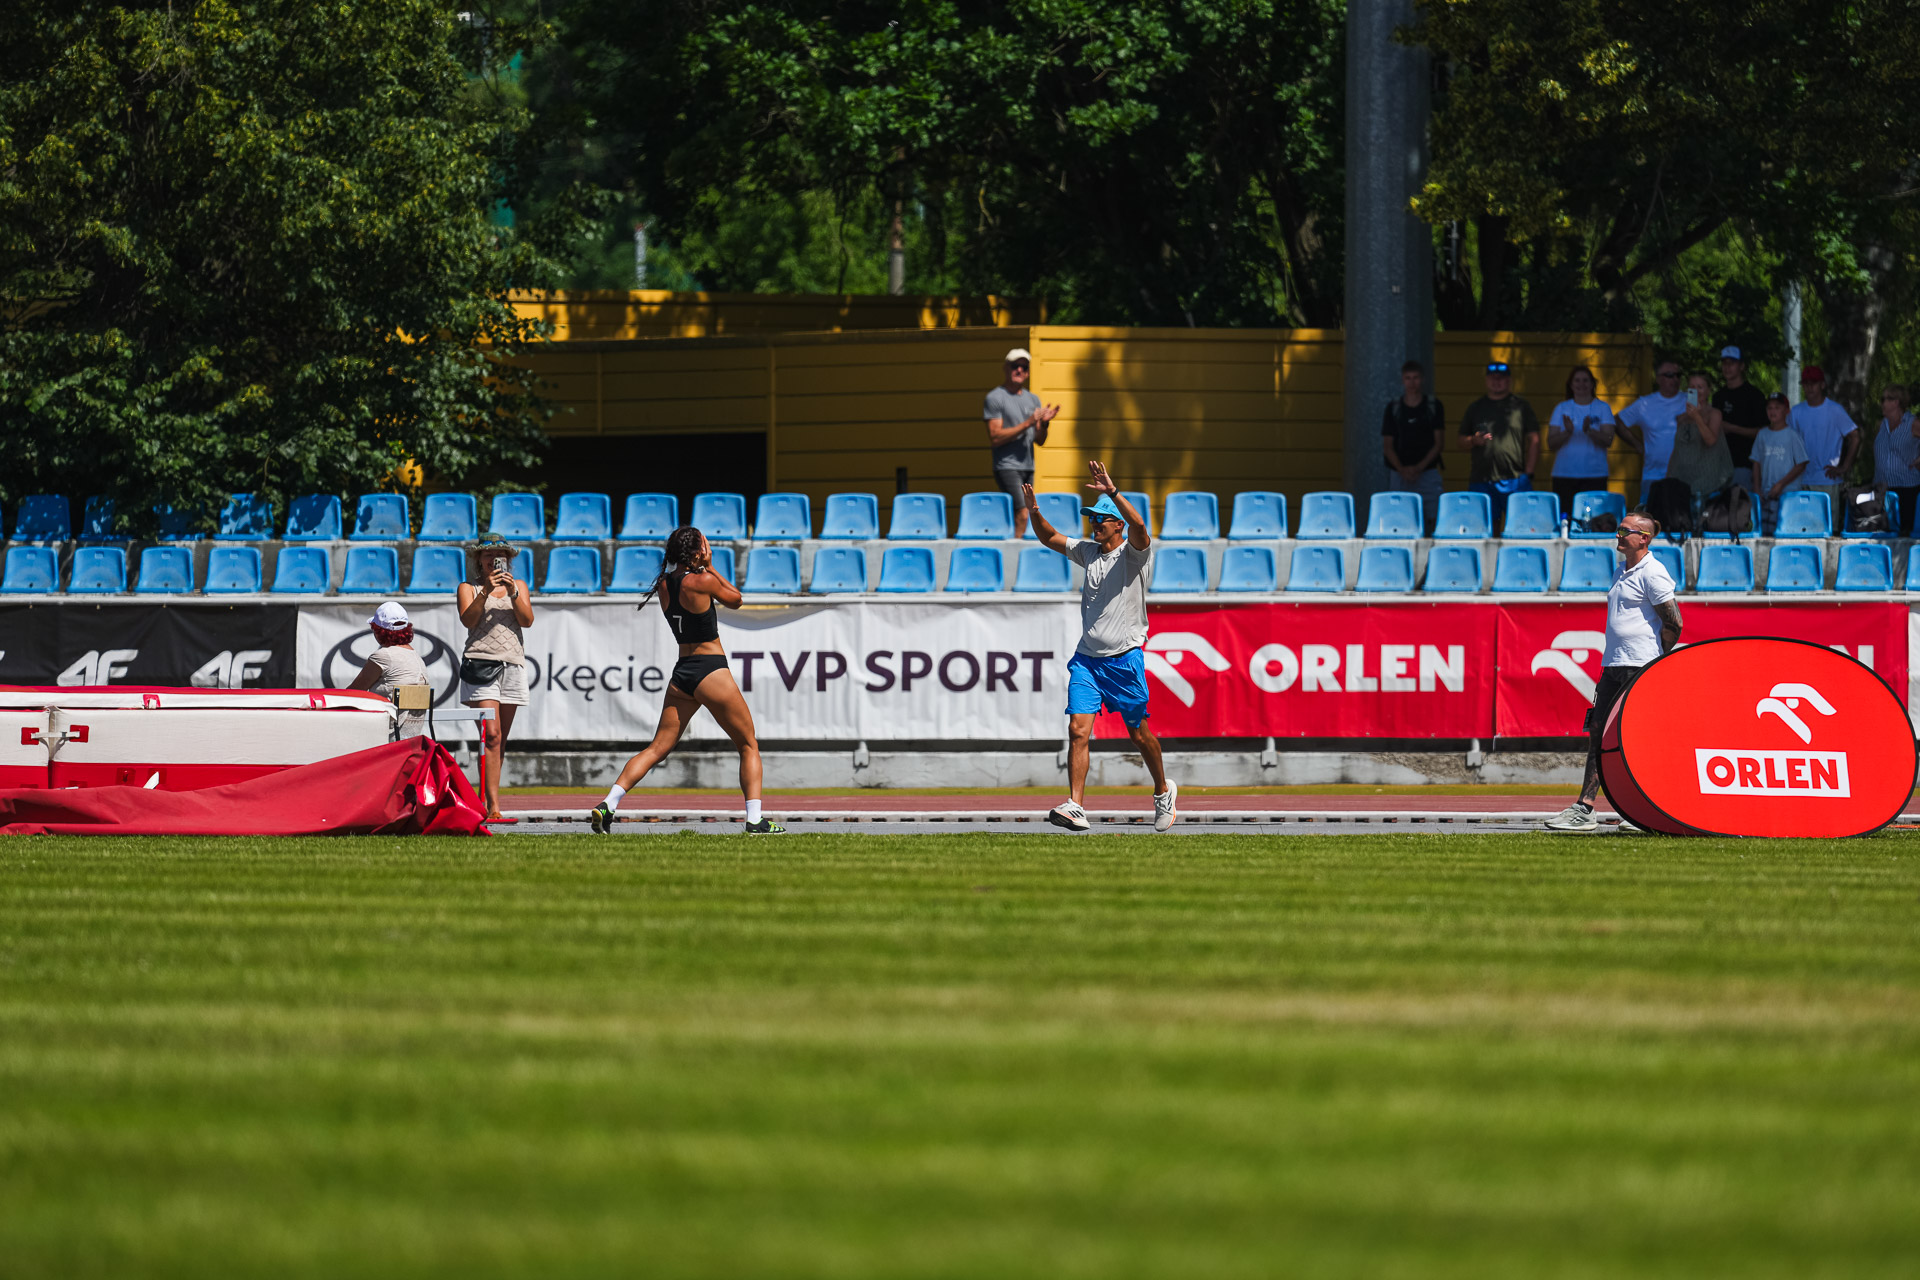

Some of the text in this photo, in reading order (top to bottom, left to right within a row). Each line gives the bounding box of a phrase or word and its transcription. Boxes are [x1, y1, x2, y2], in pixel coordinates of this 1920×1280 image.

[672, 615, 683, 634] 7
[56, 649, 139, 687] 4F
[190, 649, 272, 689] 4F
[731, 650, 1054, 692] TVP SPORT
[1249, 643, 1465, 693] ORLEN
[1706, 756, 1839, 790] ORLEN
